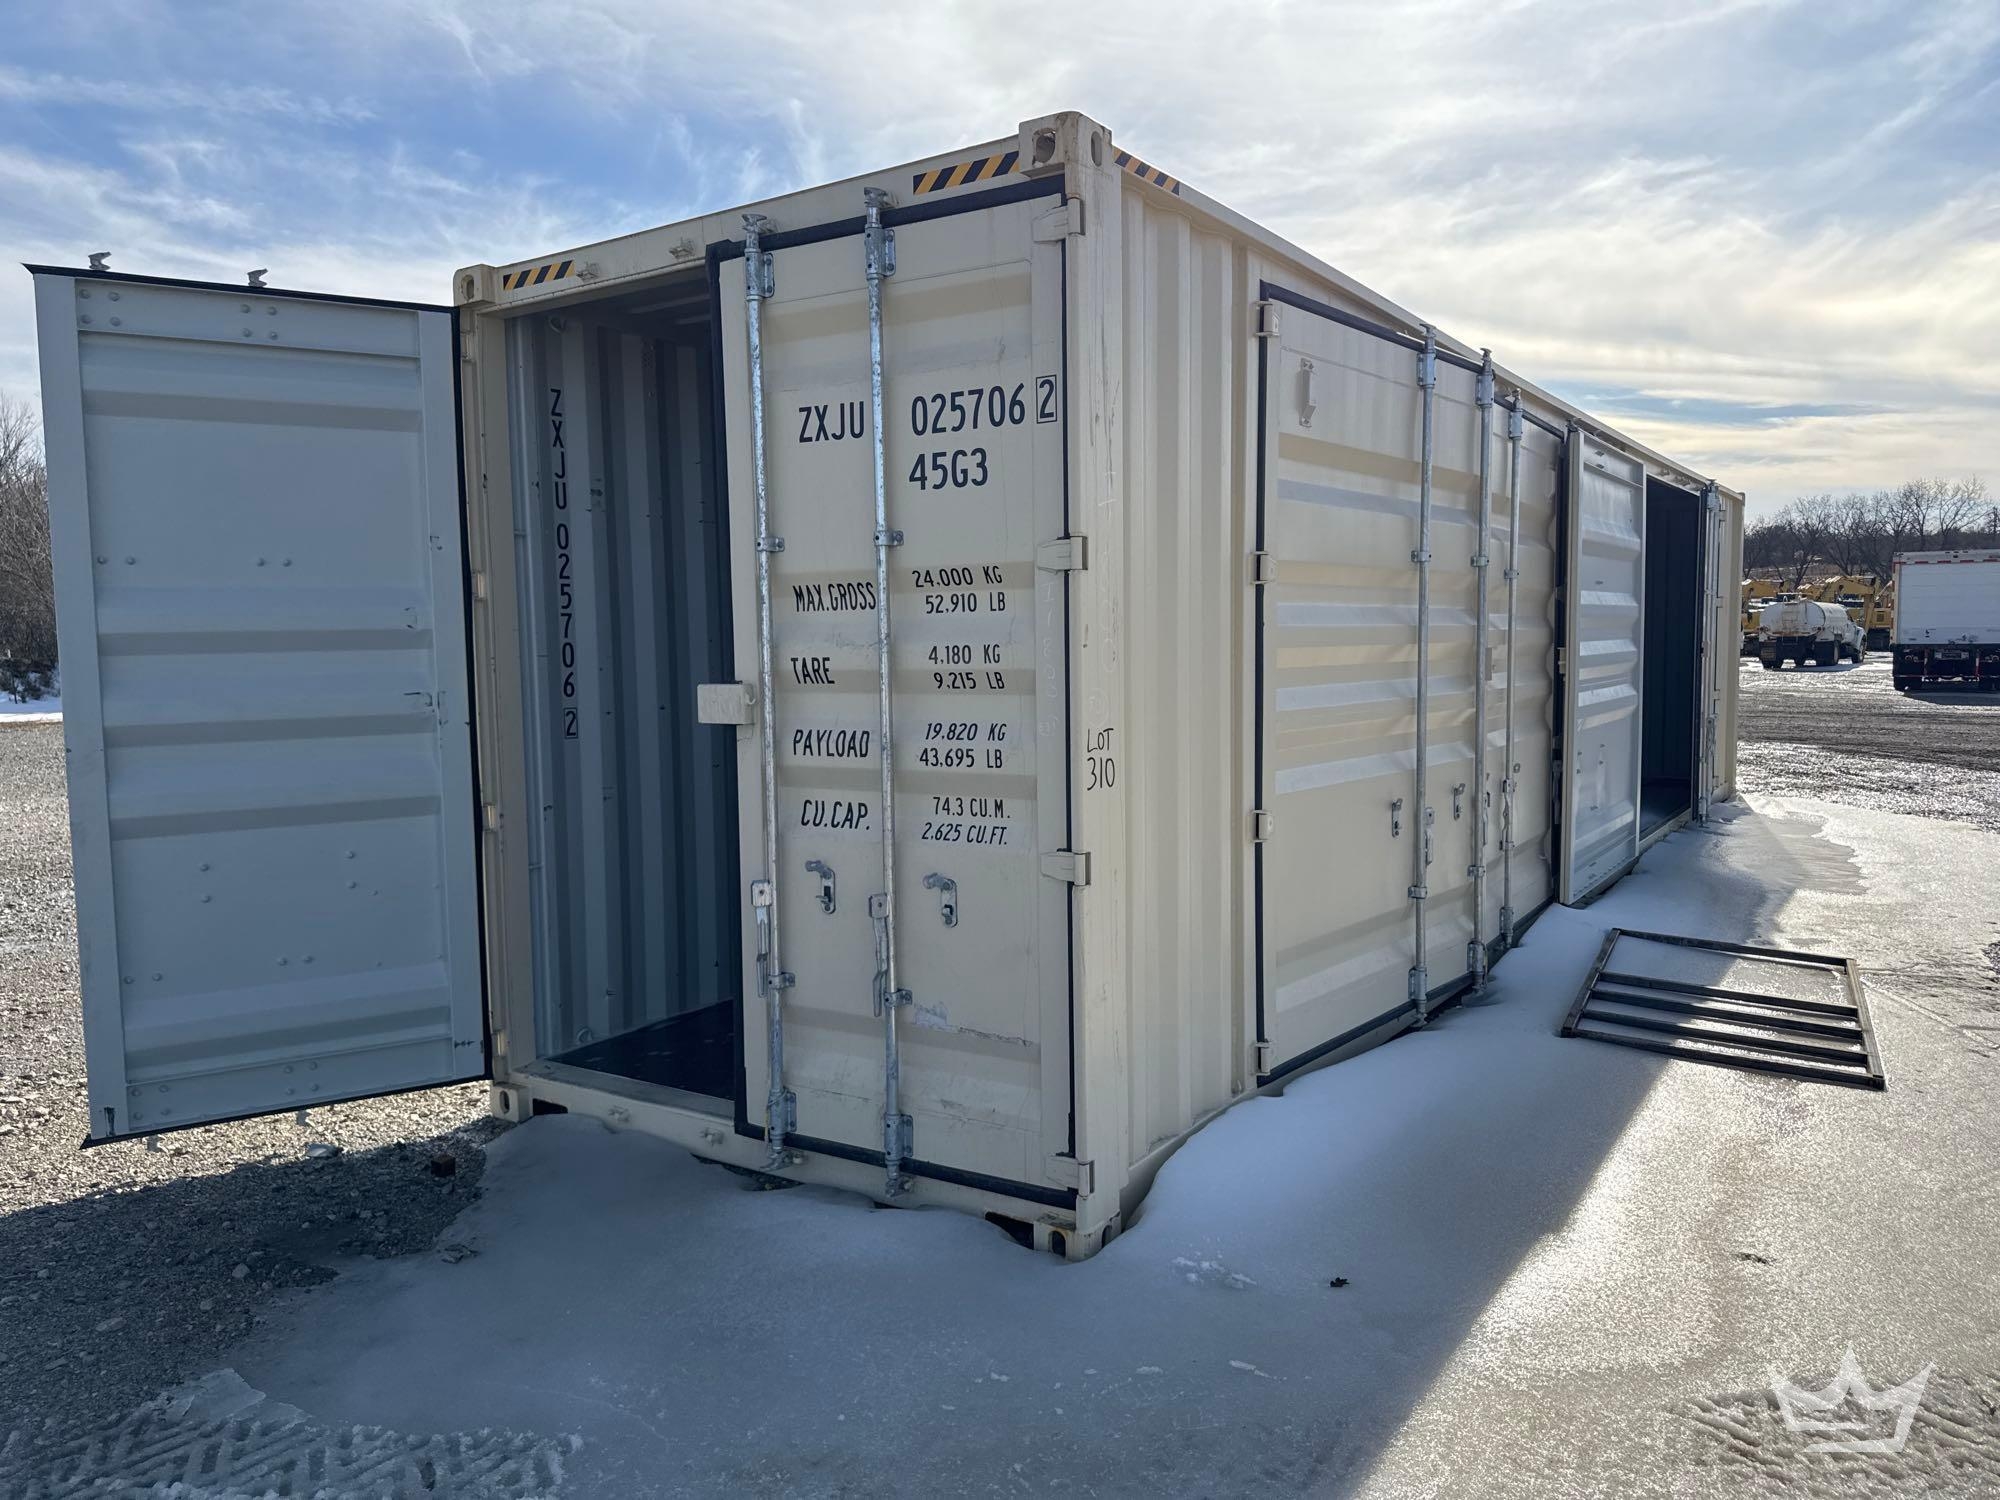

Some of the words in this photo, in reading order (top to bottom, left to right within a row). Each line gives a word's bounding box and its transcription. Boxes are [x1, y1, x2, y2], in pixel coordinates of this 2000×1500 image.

[799, 401, 864, 443] ZXJU
[912, 383, 1025, 436] 025706
[1038, 377, 1055, 421] 2
[551, 389, 567, 509] ZXJU
[909, 448, 987, 490] 45G3
[983, 566, 1002, 584] KG
[557, 523, 575, 698] 025706
[793, 582, 876, 612] MAX.GROSS
[990, 592, 1005, 611] LB
[984, 644, 1000, 663] KG
[791, 657, 835, 684] TARE
[986, 672, 1004, 689] LB
[564, 709, 577, 738] 2
[988, 723, 1006, 741] KG
[794, 730, 870, 757] PAYLOAD
[1087, 728, 1114, 752] LOT
[987, 749, 1002, 768] LB
[1087, 757, 1115, 791] 310
[801, 800, 869, 830] CU.CAP.
[933, 797, 963, 816] 74.3
[970, 799, 1010, 818] CU.M.
[967, 825, 1007, 845] CU.FT.
